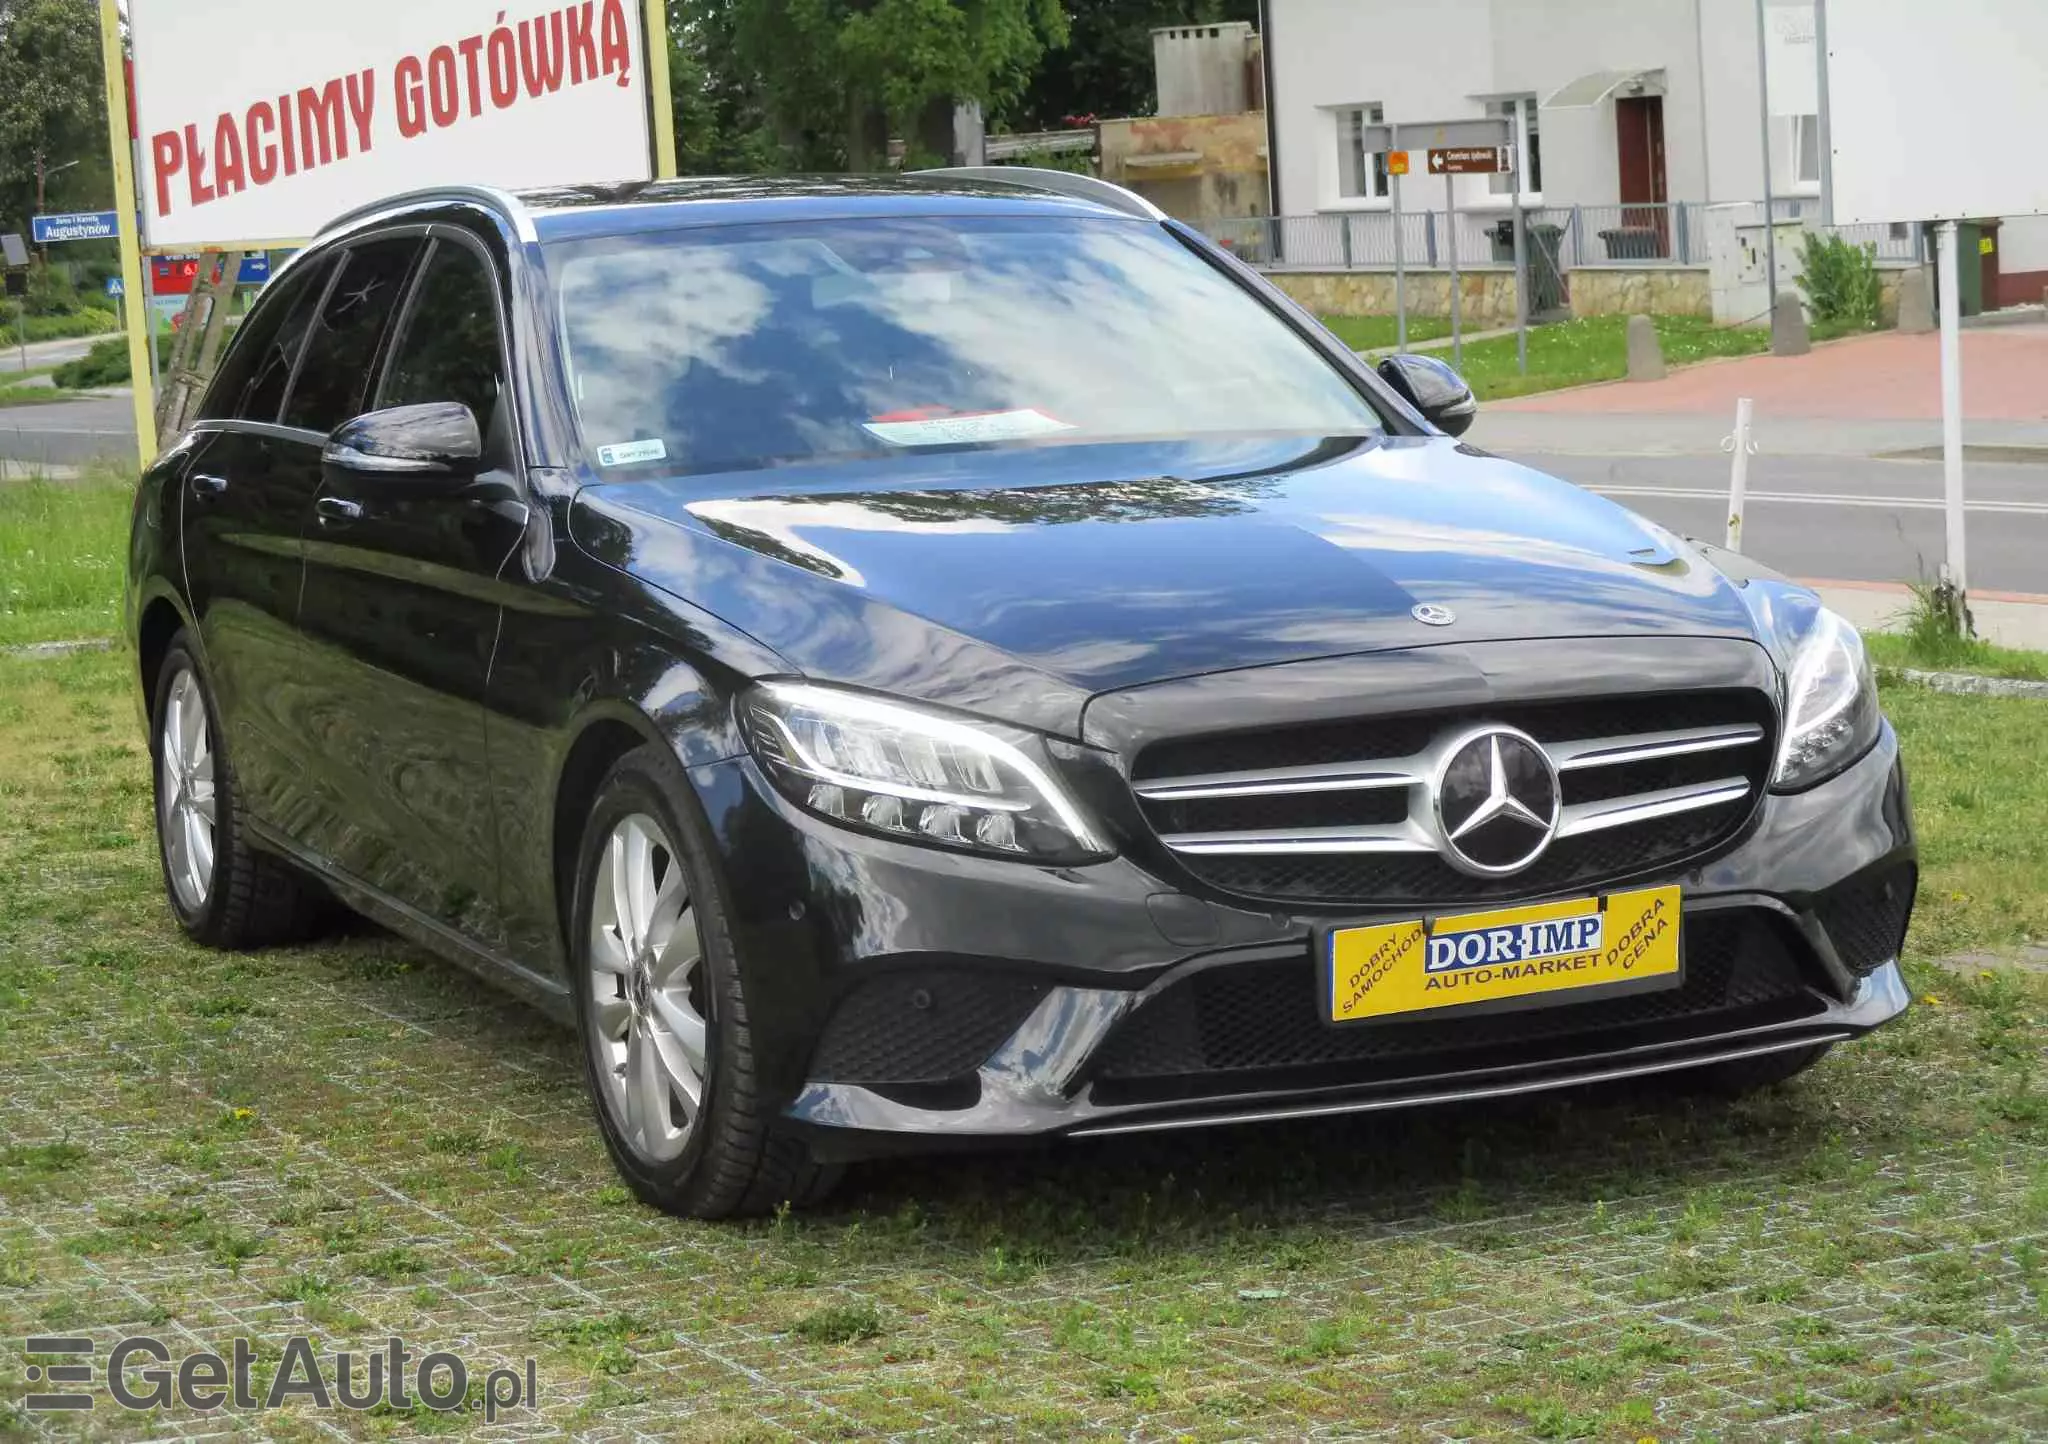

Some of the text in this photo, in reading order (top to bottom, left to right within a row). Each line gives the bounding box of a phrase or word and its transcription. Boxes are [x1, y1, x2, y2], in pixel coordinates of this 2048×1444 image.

[152, 0, 631, 217] PŁACIMY GOTÓWKĄ
[46, 223, 110, 240] Augustynów
[1606, 898, 1665, 966] DOBRA
[1623, 918, 1668, 969] CENA
[1350, 932, 1397, 988] DOBRY
[1425, 953, 1602, 991] AUTO-MARKET
